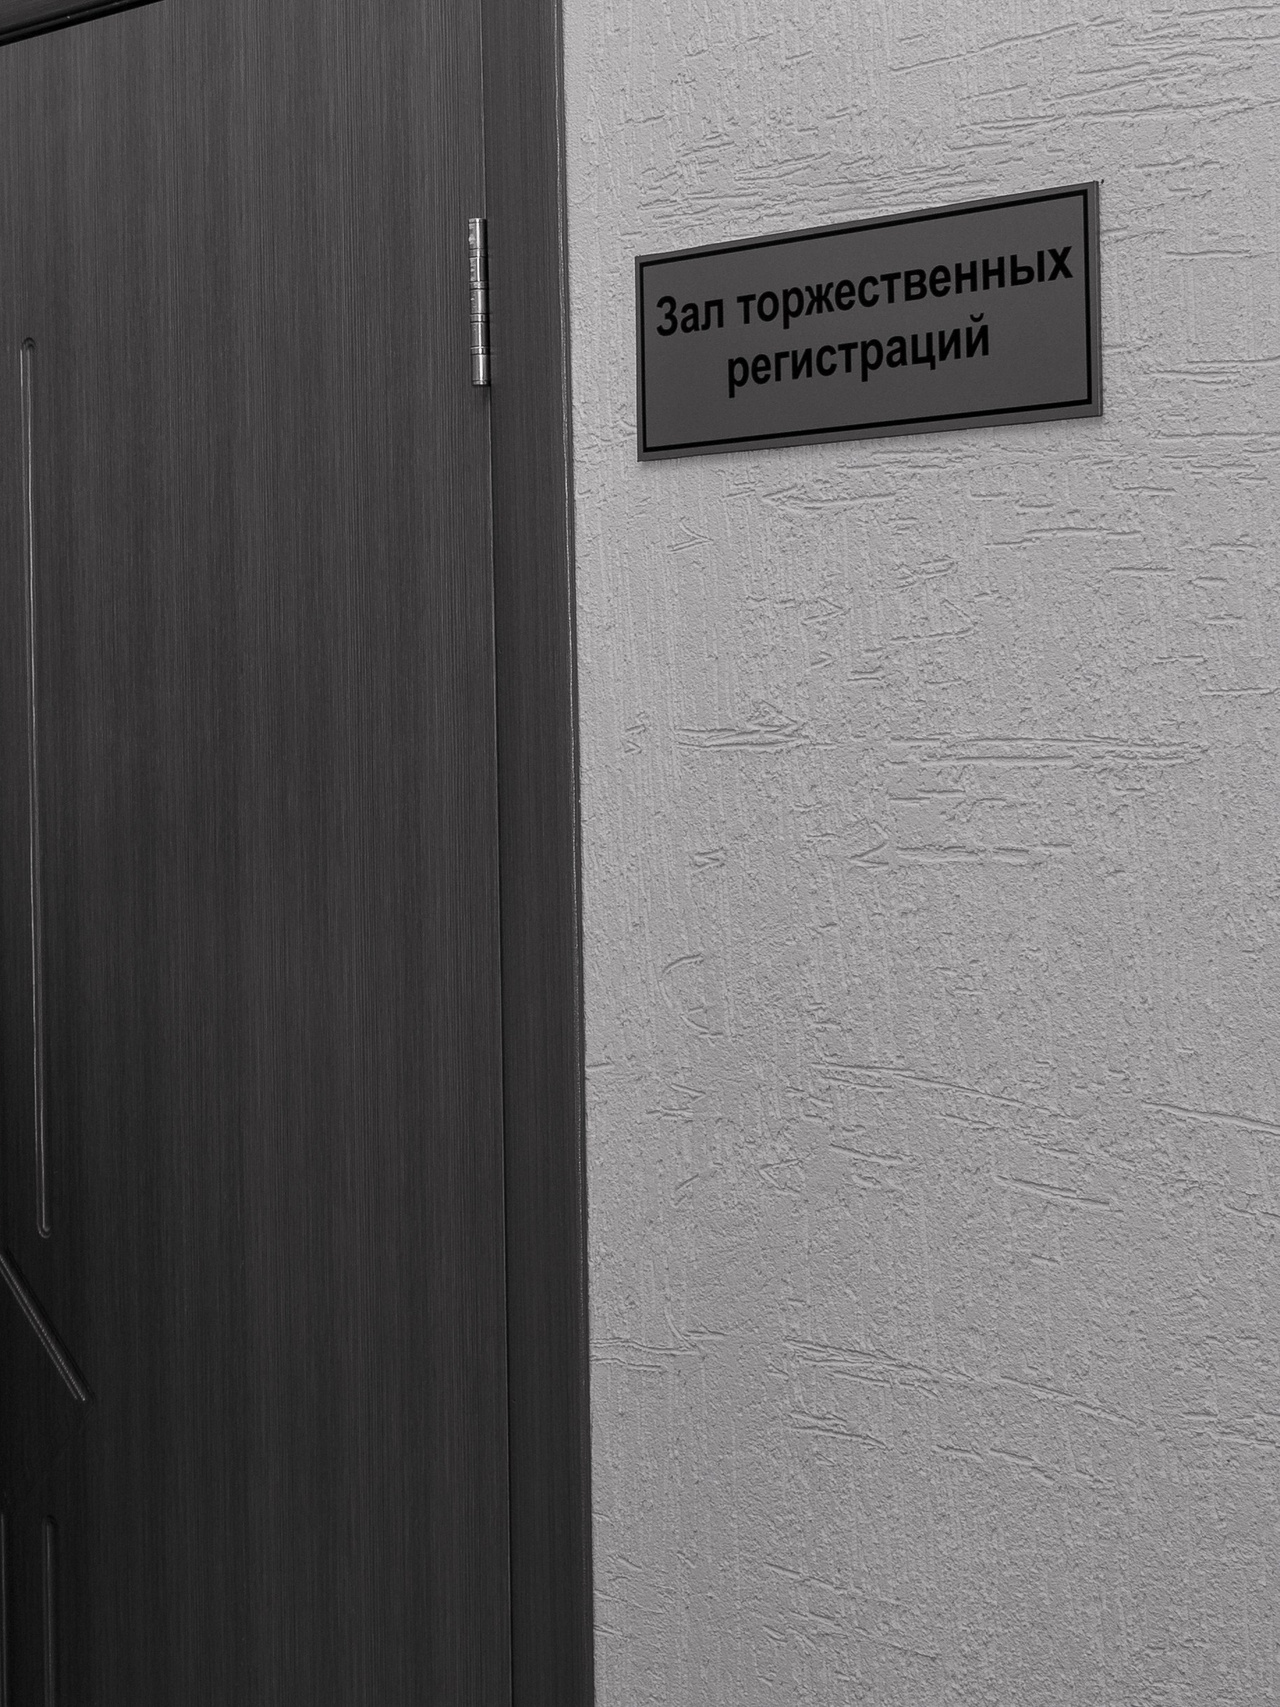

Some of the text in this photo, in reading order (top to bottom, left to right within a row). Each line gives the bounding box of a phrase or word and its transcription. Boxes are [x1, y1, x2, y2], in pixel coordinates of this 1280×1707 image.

[656, 245, 1074, 337] Зал торжественных
[727, 312, 990, 399] регистраций
